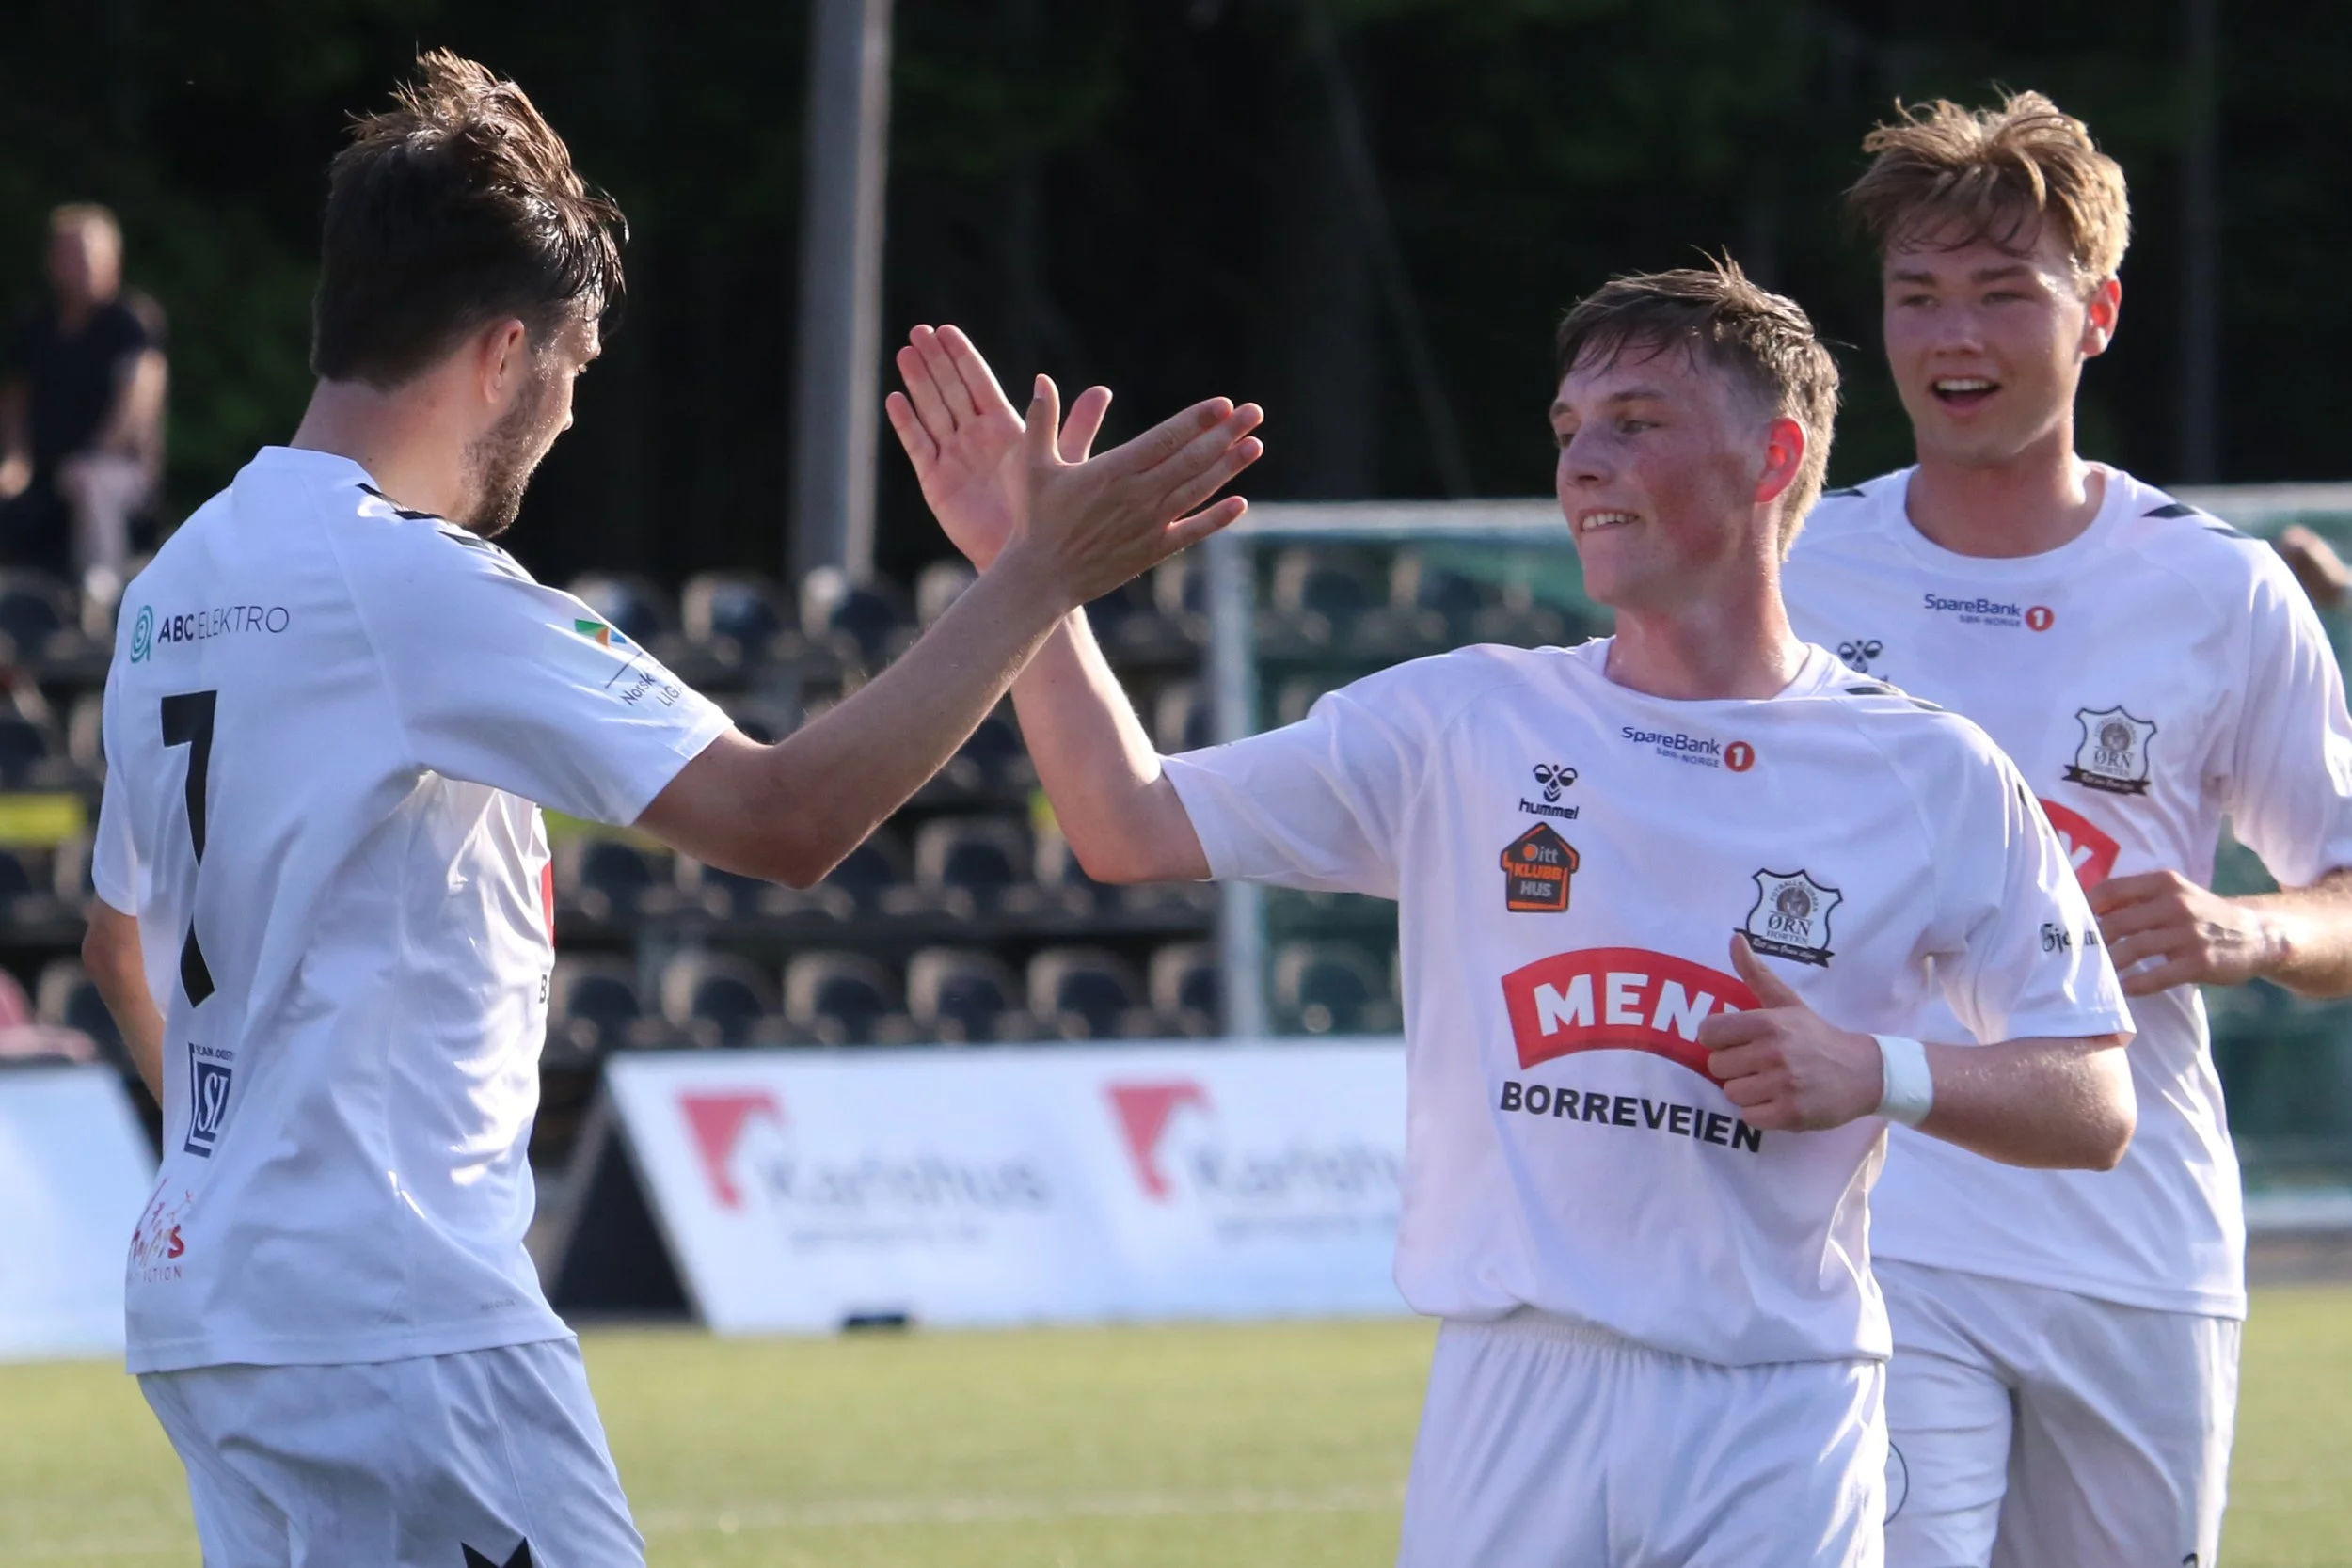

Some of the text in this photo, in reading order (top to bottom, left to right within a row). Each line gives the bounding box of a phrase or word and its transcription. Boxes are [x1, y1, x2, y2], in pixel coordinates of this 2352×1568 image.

[1924, 594, 2021, 617] SpareBank
[158, 606, 289, 644] ABC ELEKTRO
[619, 672, 657, 707] Norsk
[1621, 726, 1721, 756] SpareBank
[1518, 798, 1580, 820] hummel
[161, 689, 217, 1008] 7
[1514, 863, 1562, 881] KLUBB
[1520, 880, 1552, 897] HUS
[1769, 912, 1813, 937] ØRN
[1534, 972, 1740, 1044] MEN
[1500, 1081, 1762, 1154] BORREVEIEN
